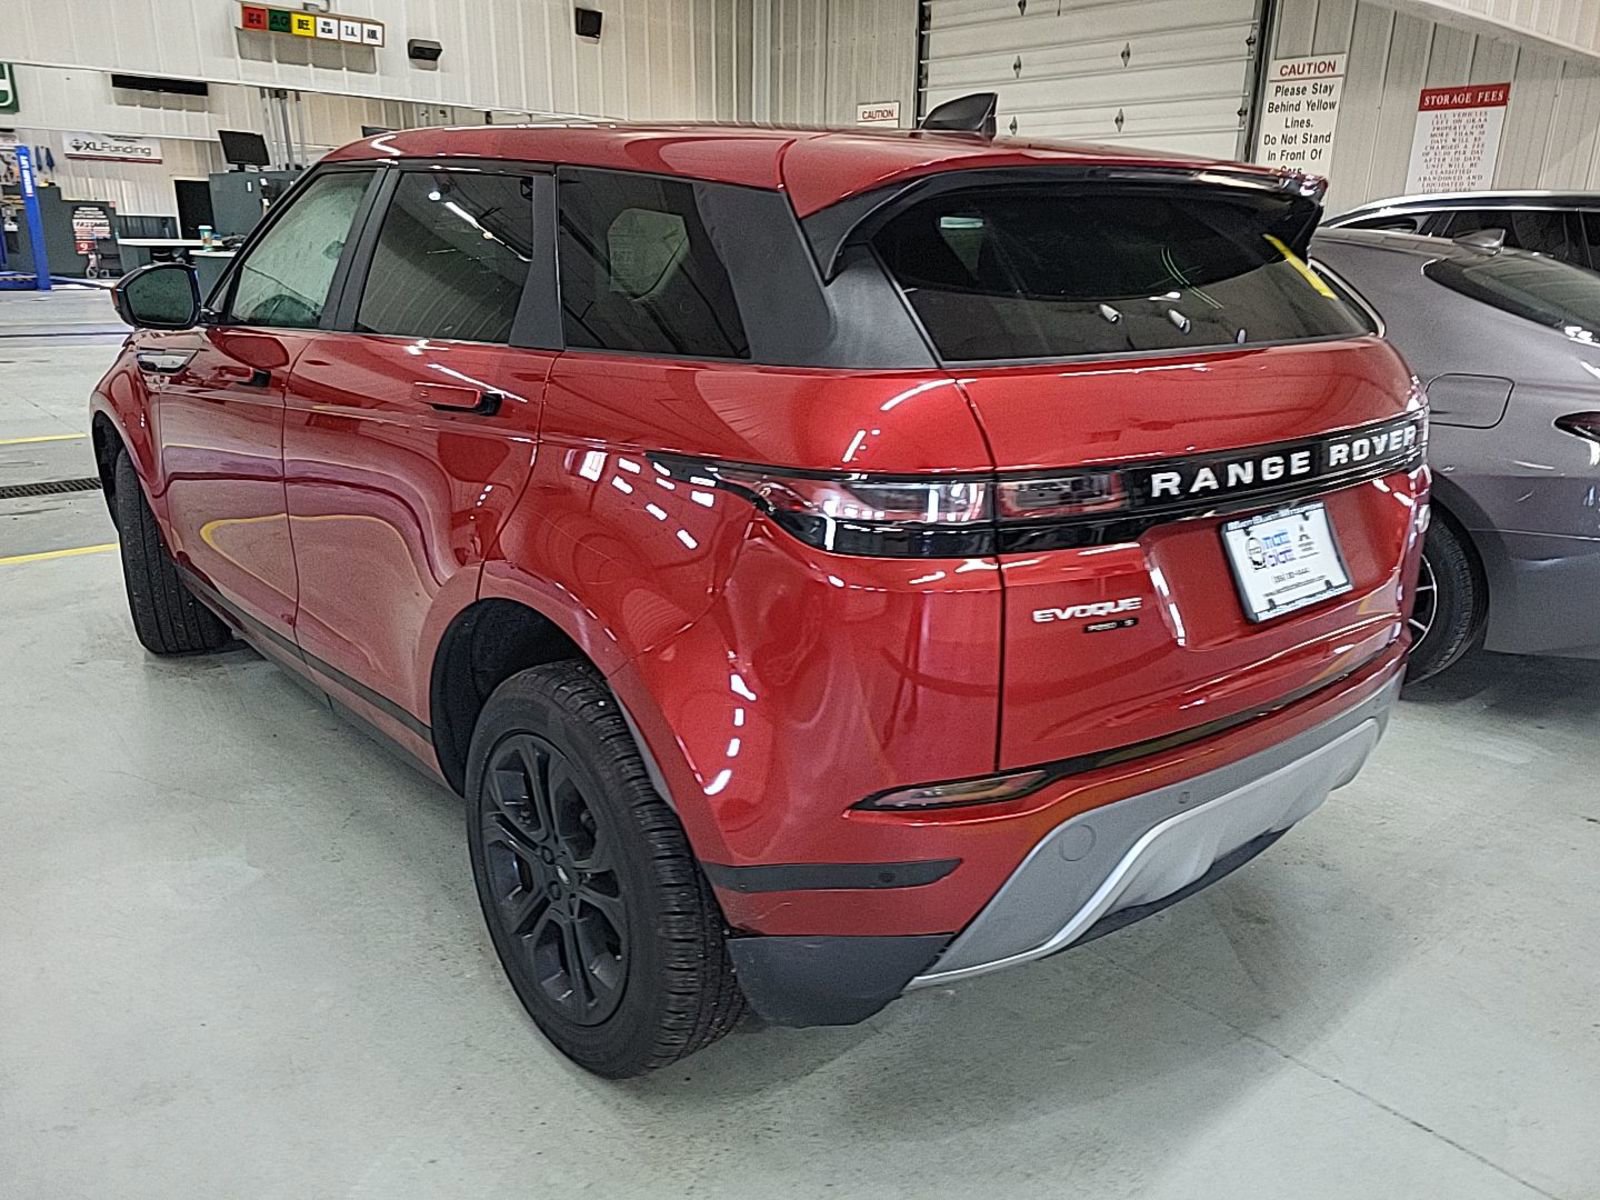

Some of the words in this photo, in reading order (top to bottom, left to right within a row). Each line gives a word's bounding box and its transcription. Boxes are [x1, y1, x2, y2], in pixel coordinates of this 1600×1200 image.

[1280, 61, 1336, 77] CAUTION
[1275, 85, 1307, 97] Please
[1312, 83, 1334, 96] Stay
[1424, 92, 1471, 106] STORAGE
[1478, 90, 1504, 103] FEES
[1268, 101, 1301, 113] Behind
[1306, 99, 1337, 111] Yellow
[862, 109, 894, 119] CAUTION
[1285, 117, 1314, 128] Lines.
[1264, 134, 1277, 145] Do
[1281, 134, 1297, 145] Not
[1302, 132, 1331, 144] Stand
[1268, 150, 1276, 161] In
[1280, 149, 1305, 160] Front
[1310, 148, 1322, 160] Of
[1151, 451, 1311, 497] RANGE
[1329, 425, 1418, 467] ROVER
[1033, 597, 1143, 623] EVOQUE
